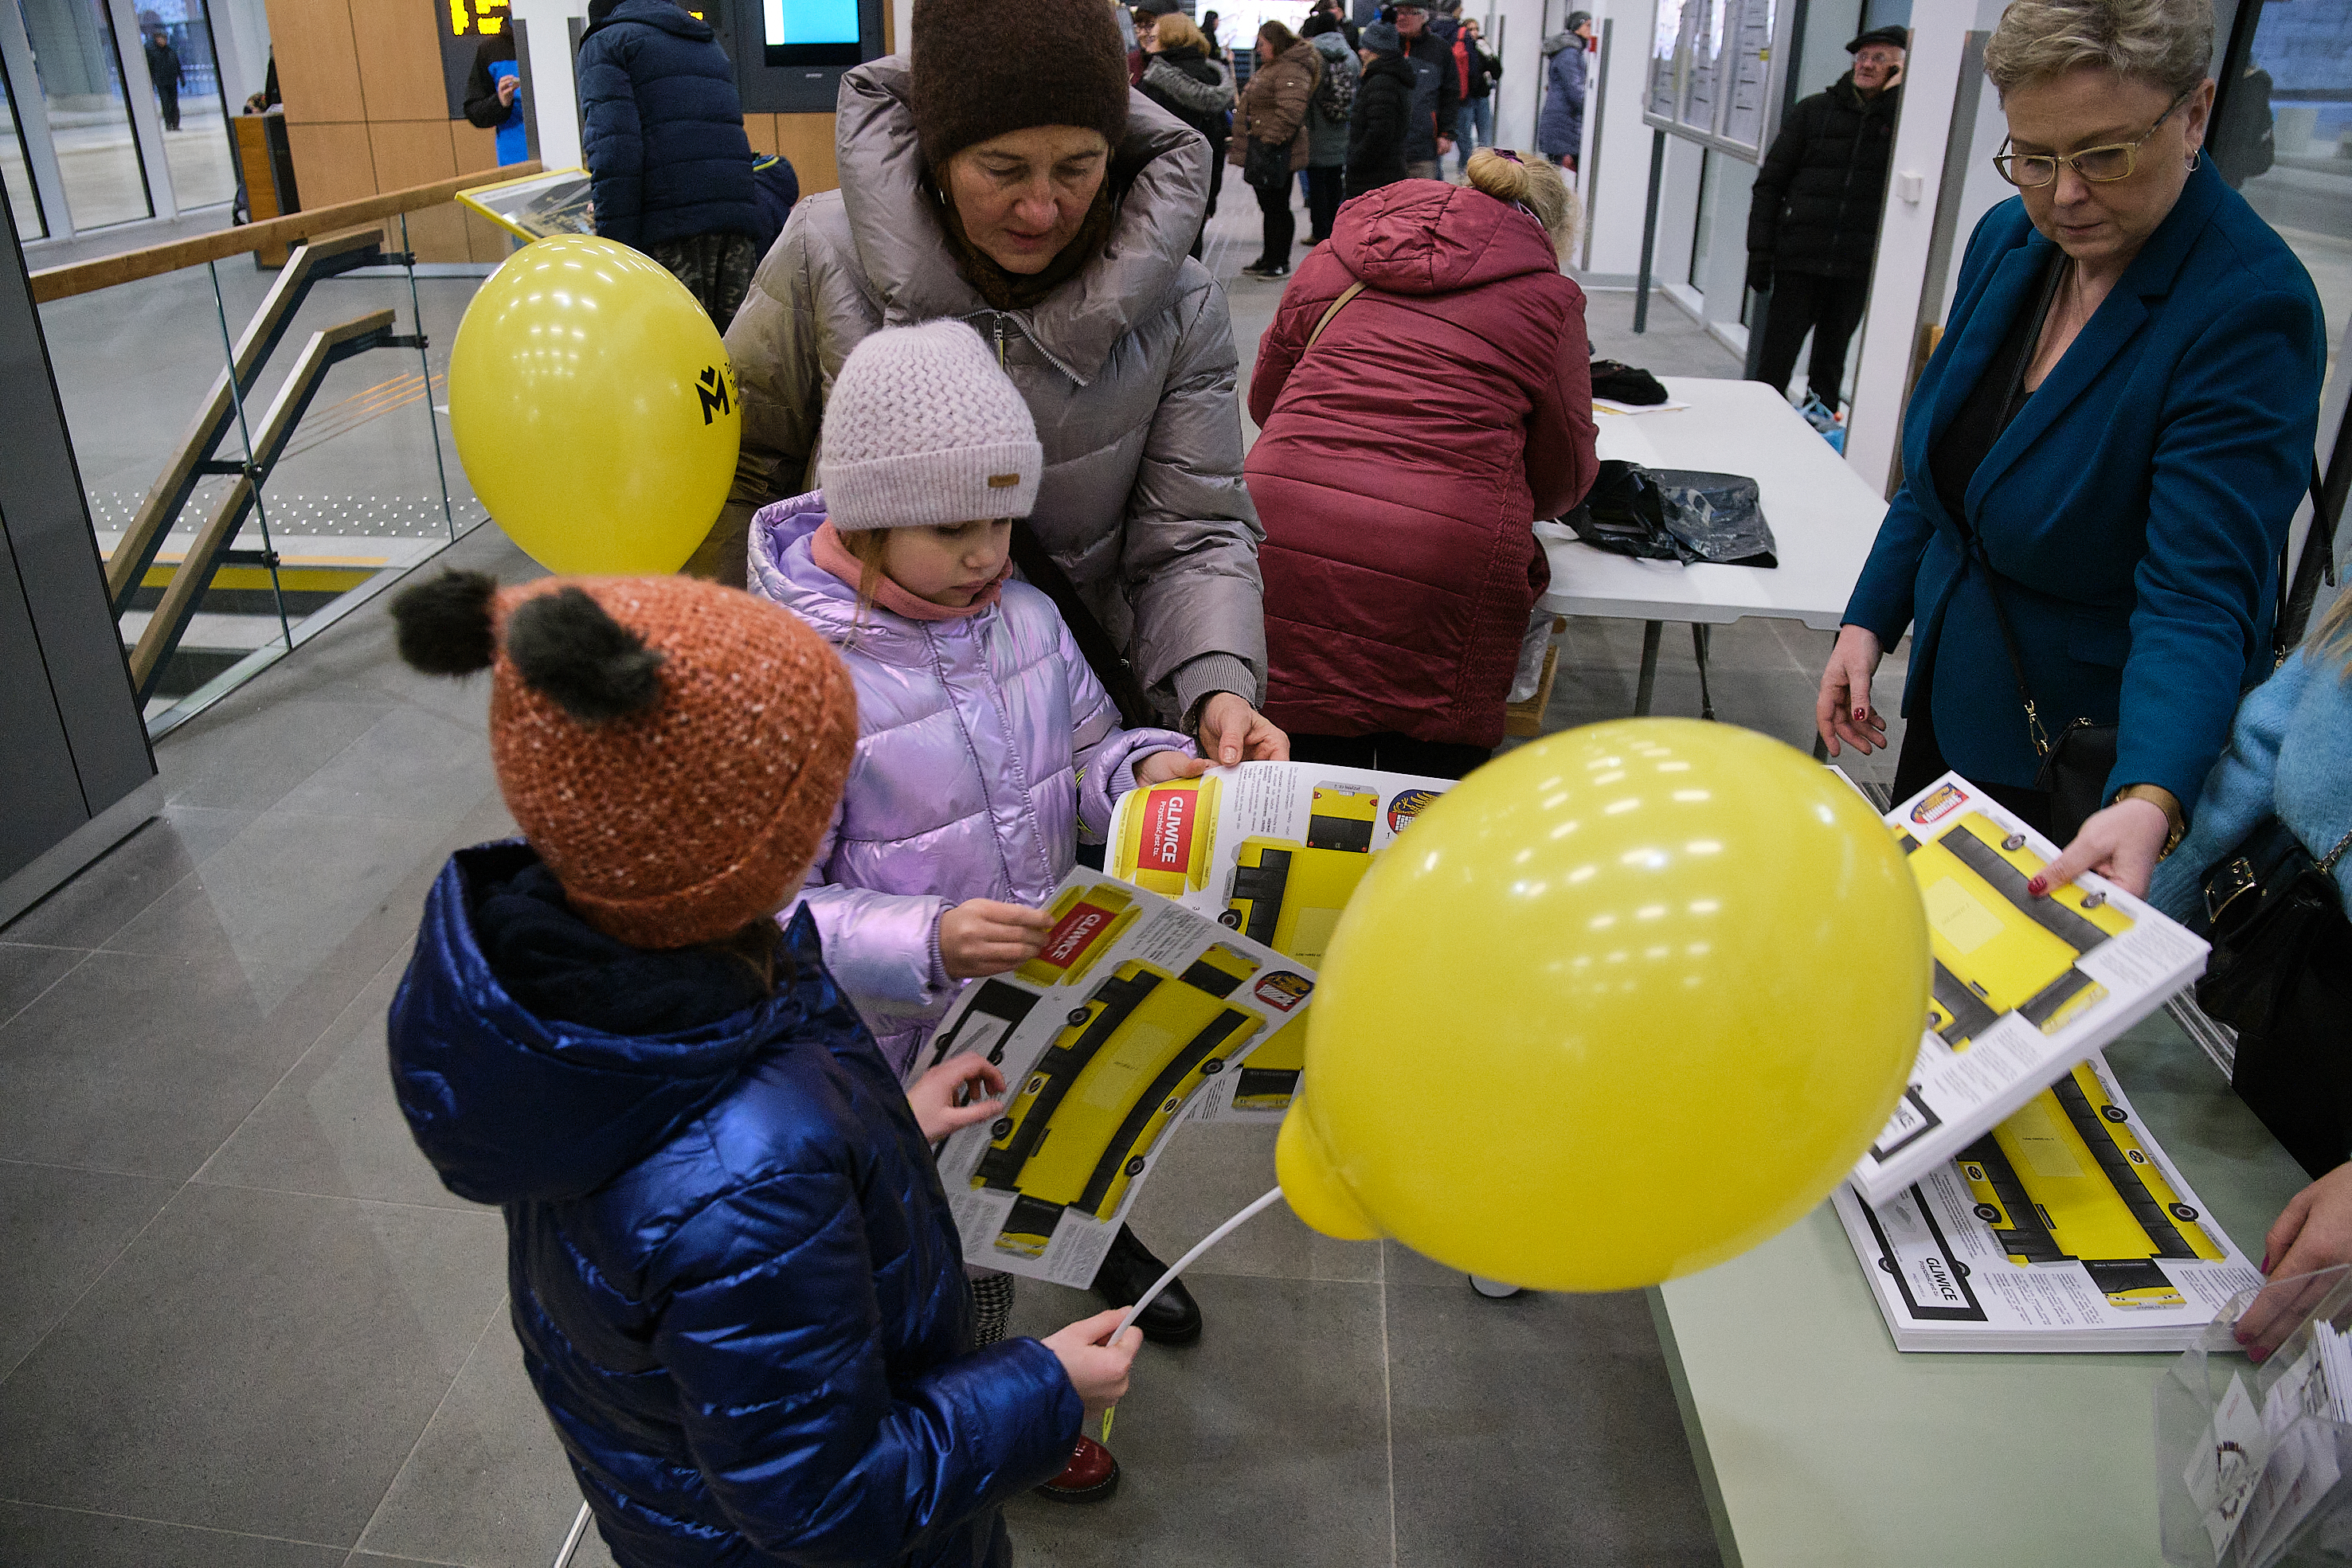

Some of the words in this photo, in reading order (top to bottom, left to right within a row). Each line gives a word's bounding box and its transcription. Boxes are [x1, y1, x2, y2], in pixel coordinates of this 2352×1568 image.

[1156, 800, 1167, 834] Przyszłość
[1161, 796, 1184, 863] GLIWICE
[1926, 1257, 1959, 1300] GLIWICE
